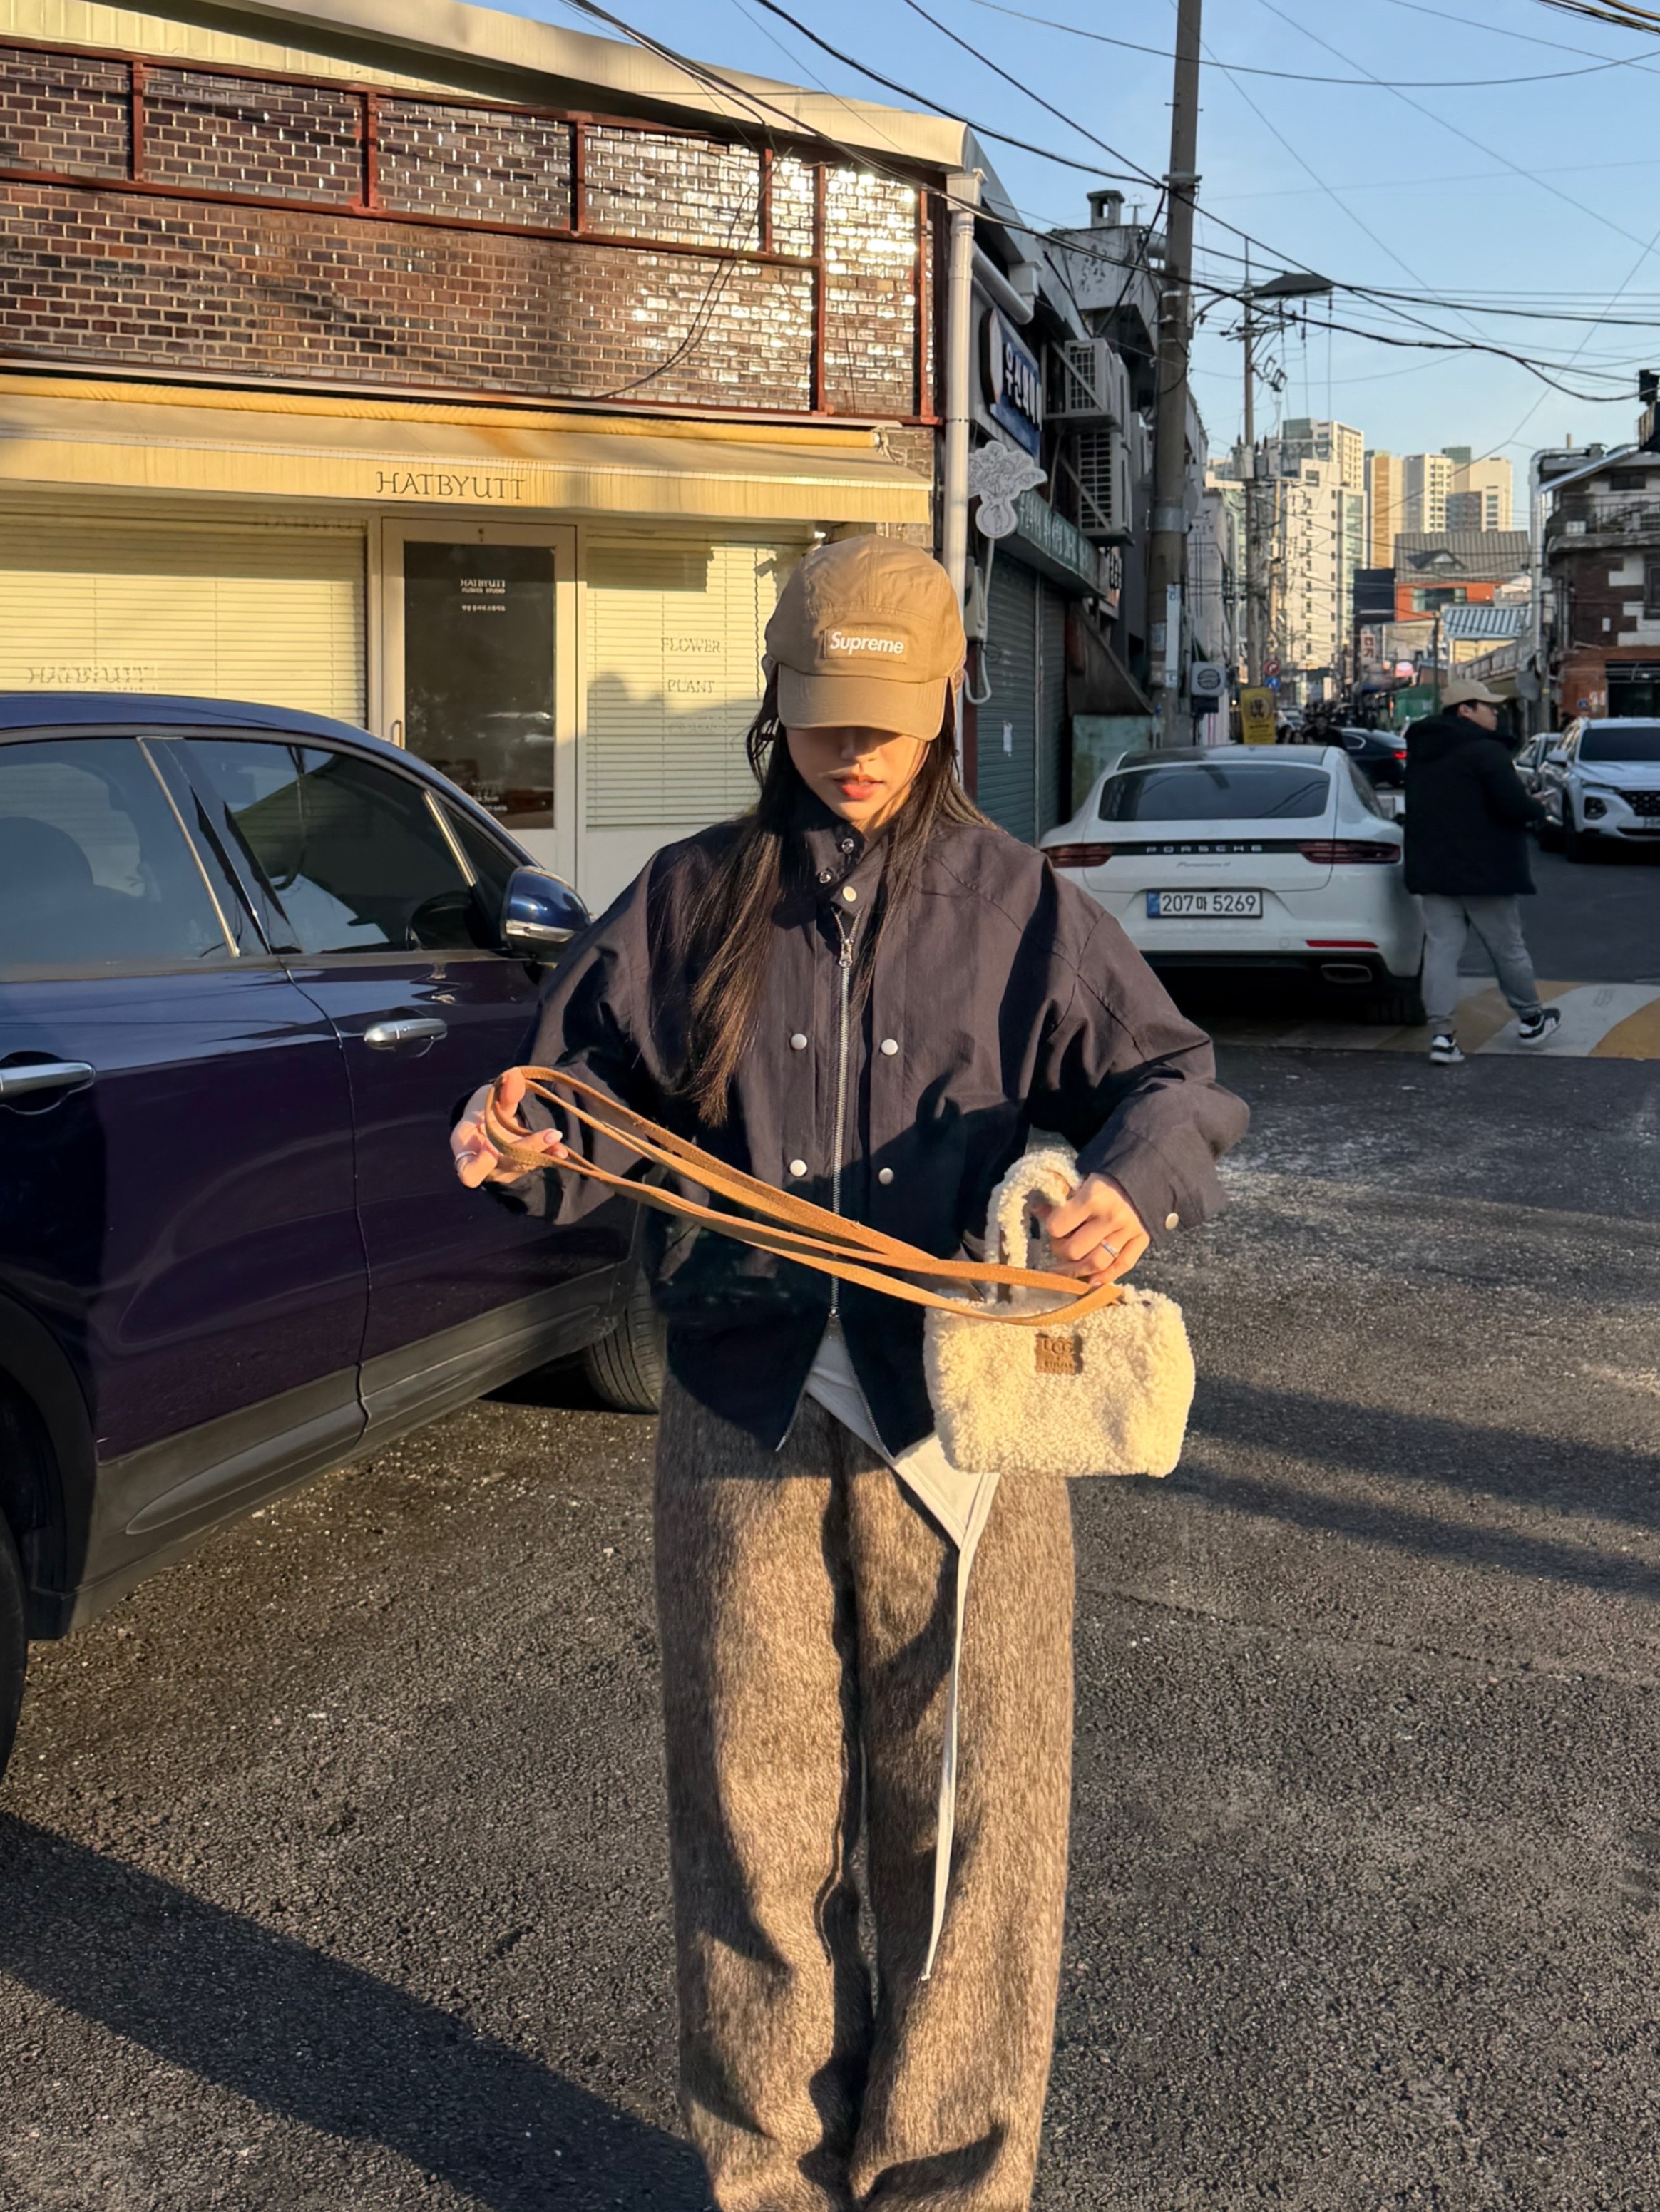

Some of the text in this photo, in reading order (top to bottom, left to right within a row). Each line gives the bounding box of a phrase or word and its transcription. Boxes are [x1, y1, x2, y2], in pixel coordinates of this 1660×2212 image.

[376, 471, 526, 499] HATBYUTT
[661, 637, 721, 653] FLOWER
[829, 631, 904, 655] Supreme
[667, 679, 714, 693] PLANT
[1146, 844, 1263, 853] PORSCHE
[1162, 895, 1256, 912] 207마 5269
